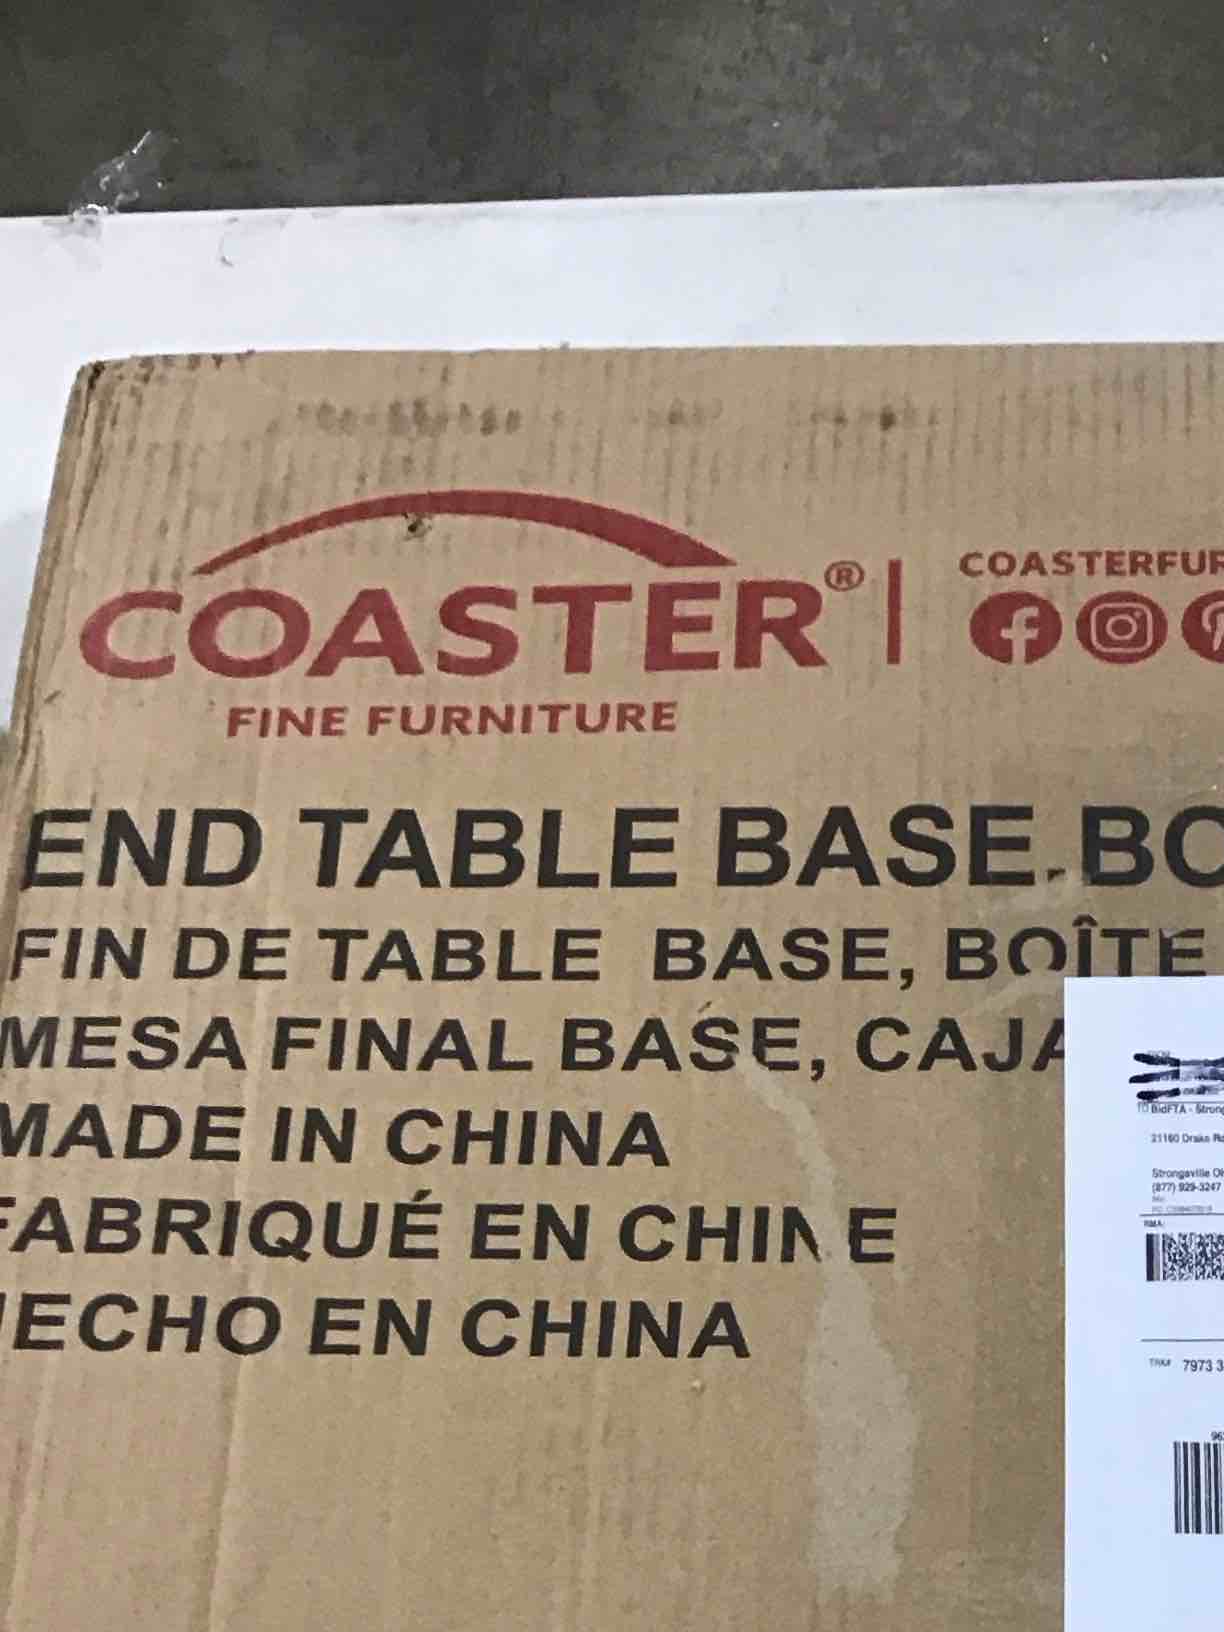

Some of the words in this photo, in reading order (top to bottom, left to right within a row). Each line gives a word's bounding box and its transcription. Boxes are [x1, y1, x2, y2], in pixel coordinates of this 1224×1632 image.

[226, 704, 348, 738] FINE
[367, 701, 678, 736] FURNITURE
[20, 806, 263, 891] END
[299, 807, 681, 890] TABLE
[10, 927, 147, 982] FIN
[173, 927, 291, 981] DE
[318, 927, 602, 982] TABLE
[652, 927, 914, 990] BASE,
[946, 914, 1207, 980] BOÎTE
[0, 1016, 247, 1070] MESA
[271, 1016, 533, 1071] FINAL
[560, 1016, 825, 1081] BASE,
[0, 1102, 246, 1162] MADE
[271, 1106, 357, 1165] IN
[386, 1109, 670, 1168] CHINA
[1151, 1104, 1187, 1114] BidFTA
[1152, 1168, 1210, 1179] Strongsville
[470, 1203, 590, 1262] EN
[618, 1204, 897, 1263] CHINE
[0, 1292, 281, 1356] ECHO
[309, 1298, 432, 1355] EN
[460, 1298, 751, 1359] CHINA
[1183, 1359, 1213, 1371] 7973
